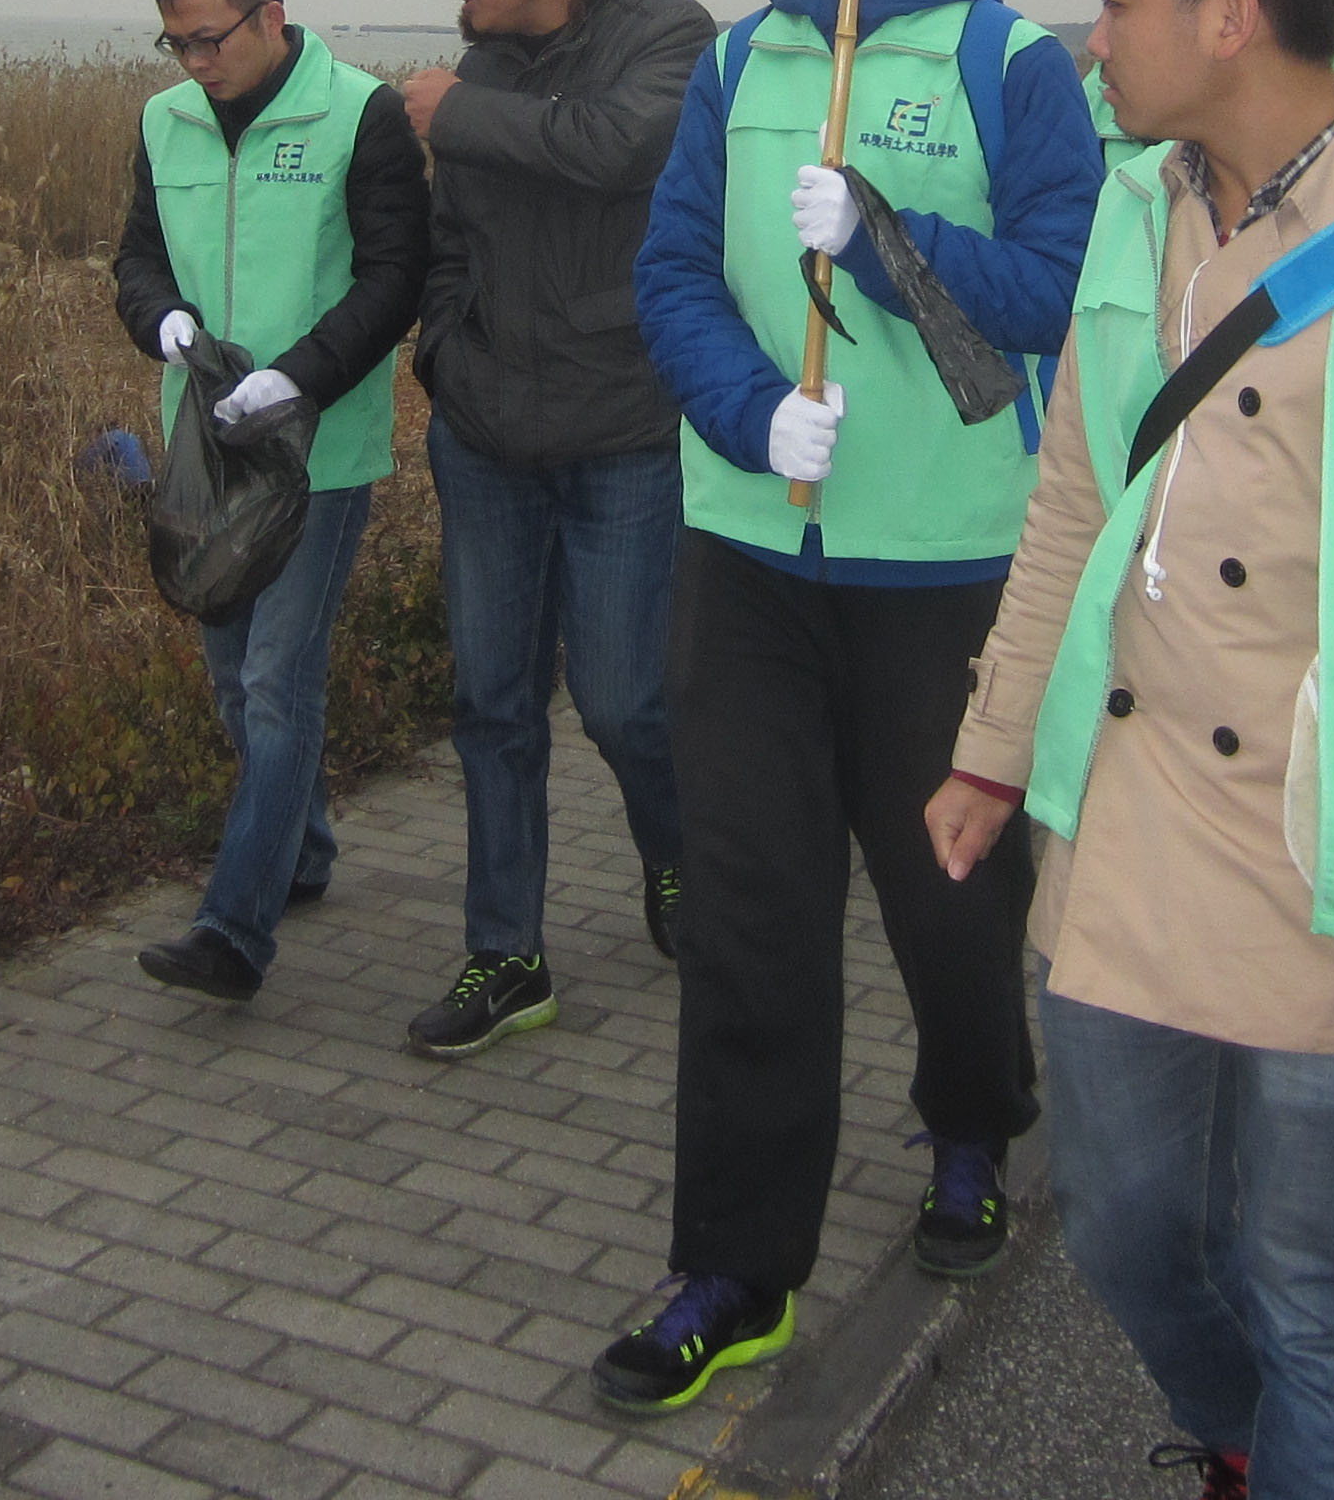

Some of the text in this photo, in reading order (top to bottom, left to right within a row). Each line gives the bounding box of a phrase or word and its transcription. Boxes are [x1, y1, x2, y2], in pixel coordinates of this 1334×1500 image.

[858, 132, 959, 158] 环境与土木工程学院
